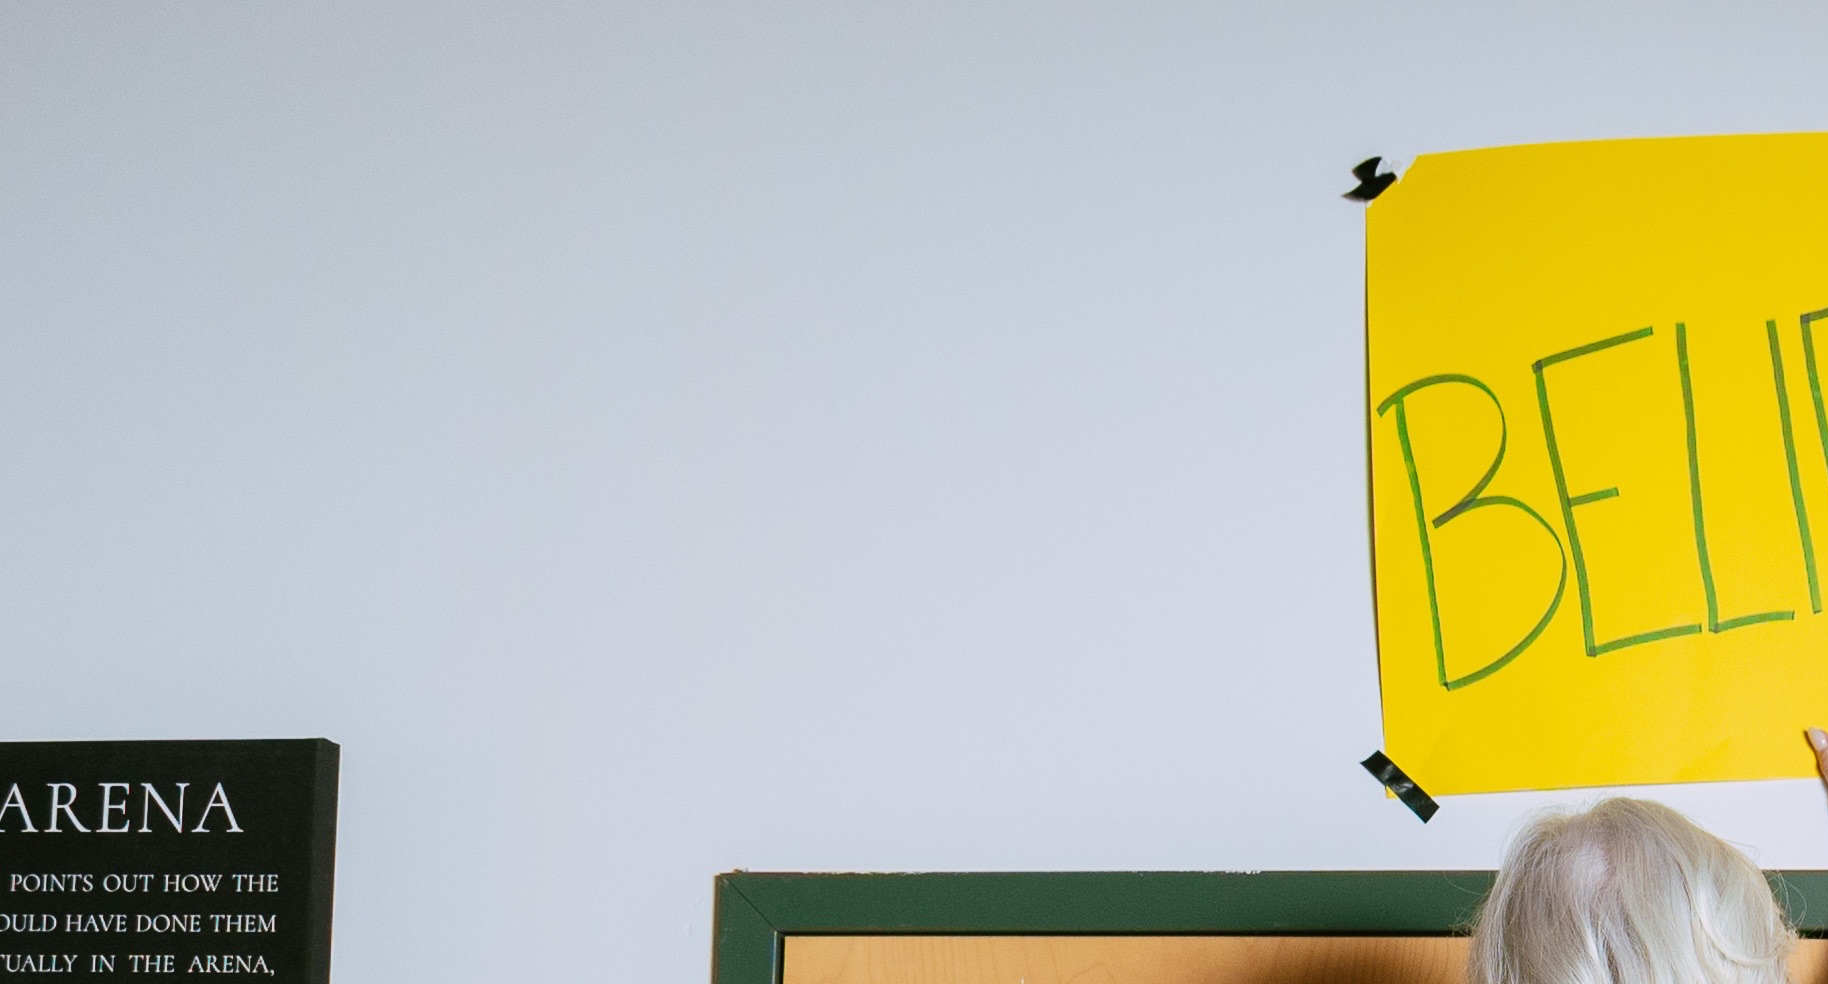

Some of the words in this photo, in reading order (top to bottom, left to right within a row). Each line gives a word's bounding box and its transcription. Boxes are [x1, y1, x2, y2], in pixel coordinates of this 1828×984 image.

[0, 781, 244, 833] ARENA
[9, 873, 94, 893] POINTS
[102, 873, 155, 893] OUT
[163, 873, 223, 893] HOW
[232, 873, 279, 893] THE
[65, 913, 127, 933] HAVE
[136, 913, 201, 933] DONE
[209, 913, 277, 933] THEM
[91, 954, 116, 973] IN
[128, 954, 175, 974] THE
[187, 954, 275, 977] ARENA,
